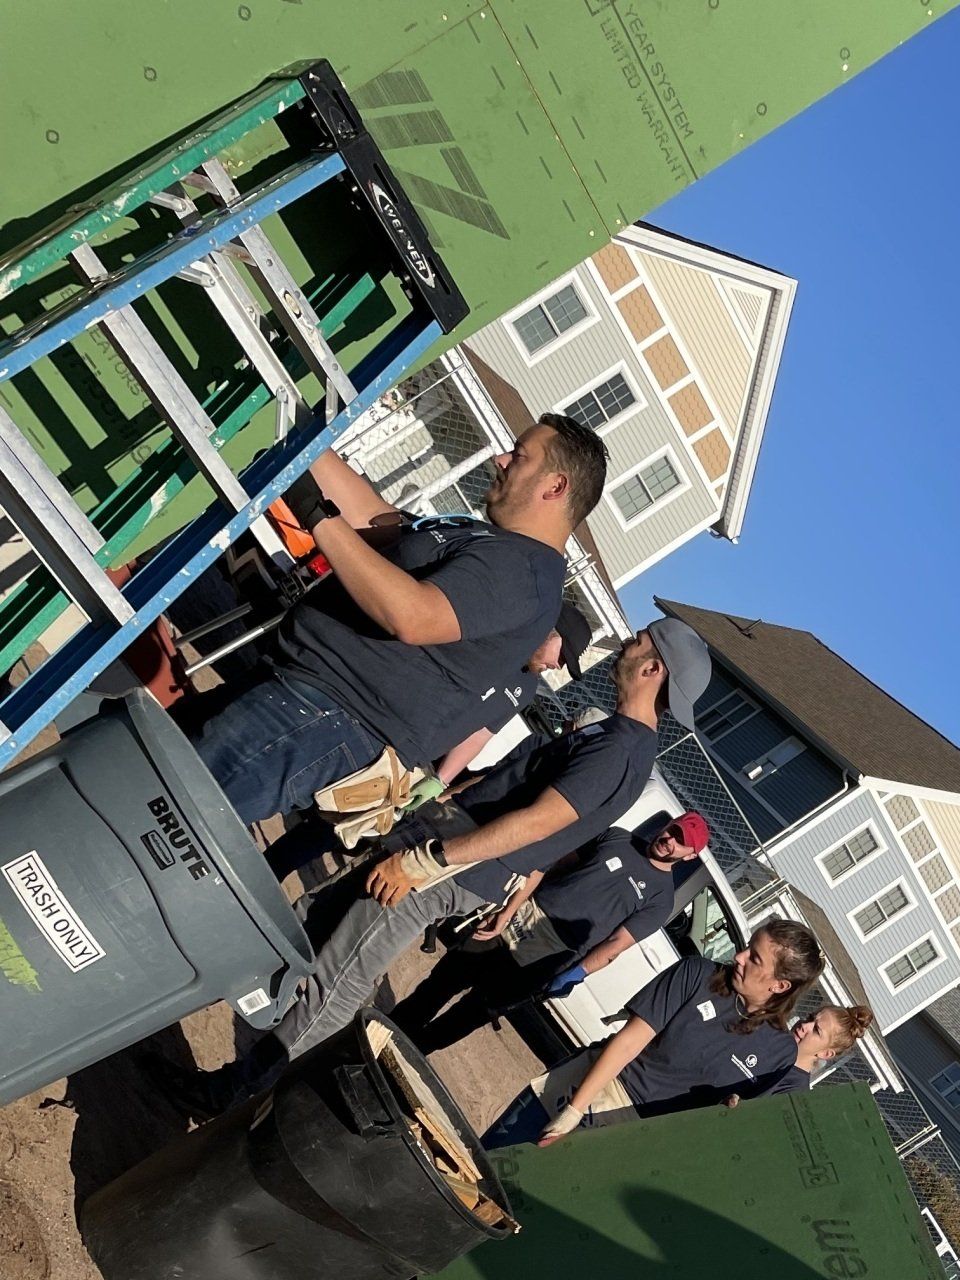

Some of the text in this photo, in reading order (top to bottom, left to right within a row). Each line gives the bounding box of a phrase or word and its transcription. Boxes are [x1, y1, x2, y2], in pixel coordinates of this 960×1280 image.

[600, 17, 641, 89] LIMITED
[625, 4, 694, 140] YEAR SYSTEM
[147, 795, 211, 881] BRUTE
[17, 862, 92, 958] TRASH ONLY
